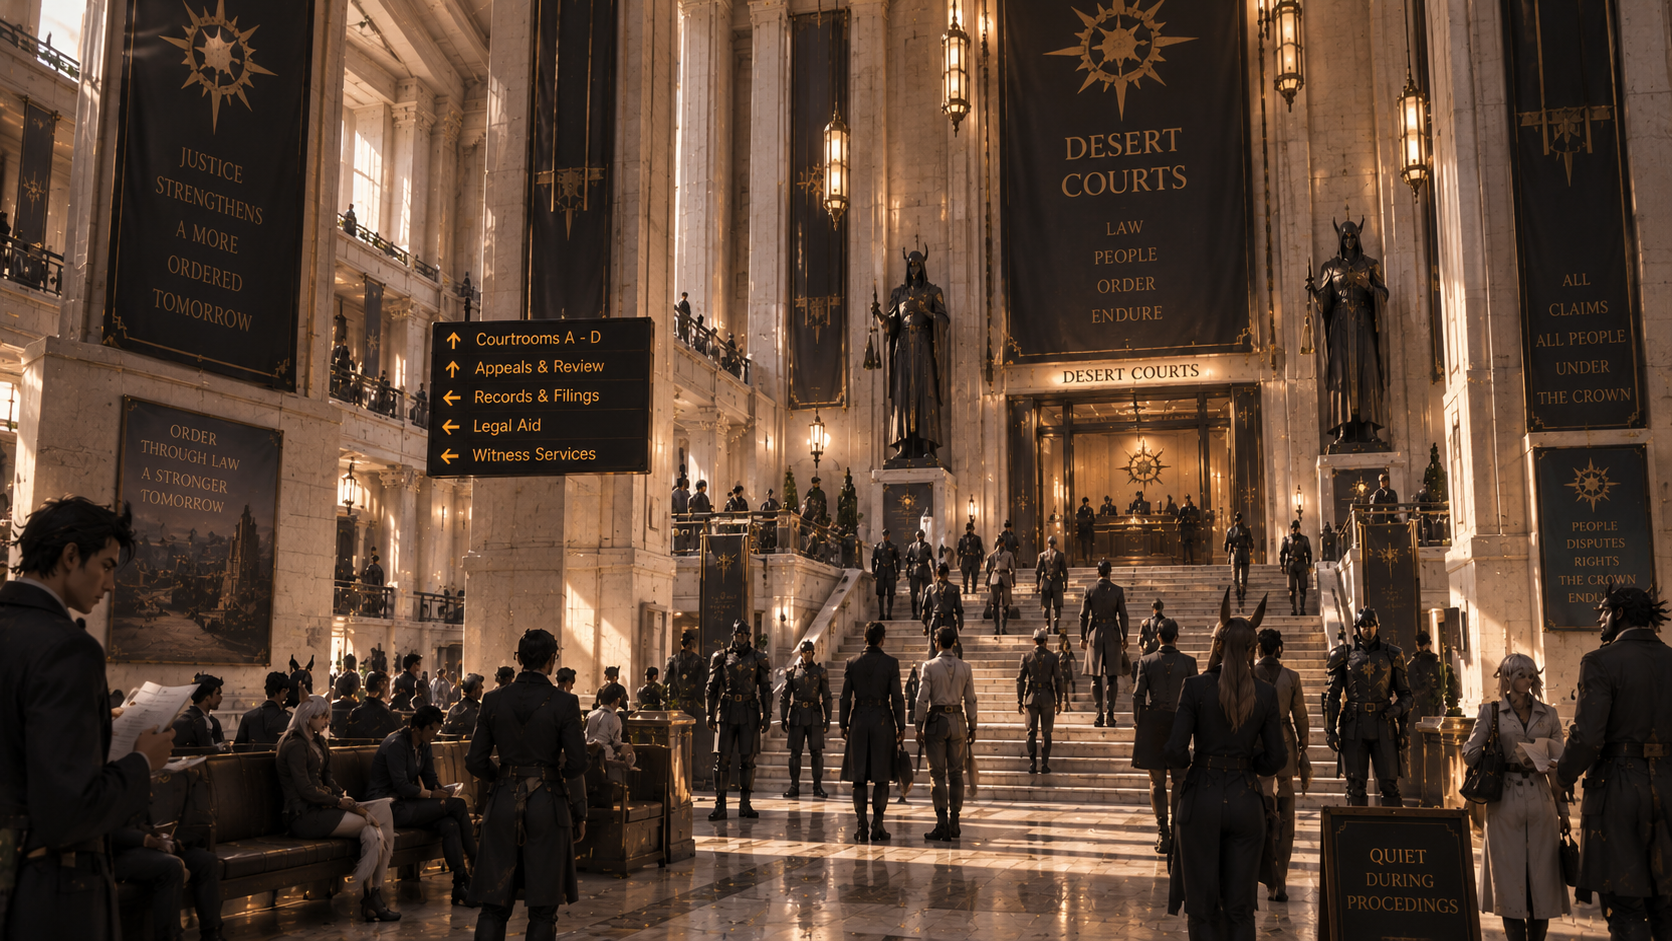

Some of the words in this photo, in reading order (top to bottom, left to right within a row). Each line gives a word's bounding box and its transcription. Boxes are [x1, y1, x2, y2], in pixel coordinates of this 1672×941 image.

[1064, 127, 1183, 161] DESERT
[179, 147, 243, 184] JUSTICE
[1061, 165, 1188, 198] COURTS
[155, 175, 263, 226] STRENGTHENS
[175, 219, 187, 240] A
[192, 223, 239, 255] MORE
[1106, 220, 1144, 236] LAW
[1094, 247, 1158, 265] PEOPLE
[167, 254, 243, 292] ORDERED
[1562, 273, 1591, 287] ALL
[1096, 276, 1156, 294] ORDER
[152, 288, 252, 332] TOMORROW
[1091, 305, 1163, 324] ENDURE
[1548, 300, 1609, 317] CLAIMS
[476, 332, 560, 347] Courtrooms
[564, 331, 575, 345] A
[590, 330, 601, 344] D
[1535, 332, 1565, 348] ALL
[1568, 329, 1627, 346] PEOPLE
[475, 360, 533, 378] Appeals
[537, 360, 549, 374] &
[554, 359, 605, 373] Review
[1063, 368, 1125, 383] DESERT
[1131, 364, 1200, 381] COURTS
[1555, 359, 1611, 376] UNDER
[474, 389, 533, 404] Records
[537, 389, 549, 403] &
[554, 388, 600, 406] Filings
[1536, 390, 1568, 405] THE
[1572, 387, 1632, 404] CROWN
[170, 424, 217, 446] ORDER
[473, 418, 512, 436] Legal
[517, 418, 541, 432] Aid
[140, 439, 207, 465] THROUGH
[211, 454, 240, 471] LAW
[472, 447, 530, 462] Witness
[535, 446, 597, 461] Services
[141, 467, 151, 480] A
[155, 468, 228, 494] STRONGER
[140, 488, 225, 513] TOMORROW
[1571, 521, 1618, 532] PEOPLE
[1566, 538, 1626, 549] DISPUTES
[1574, 556, 1620, 567] RIGHTS
[1558, 575, 1584, 586] THE
[1587, 574, 1637, 585] CROWN
[1568, 592, 1605, 603] ENDU
[1369, 848, 1427, 865] QUIET
[1366, 872, 1434, 888] DURING
[1346, 895, 1459, 914] PROCEDINGS
